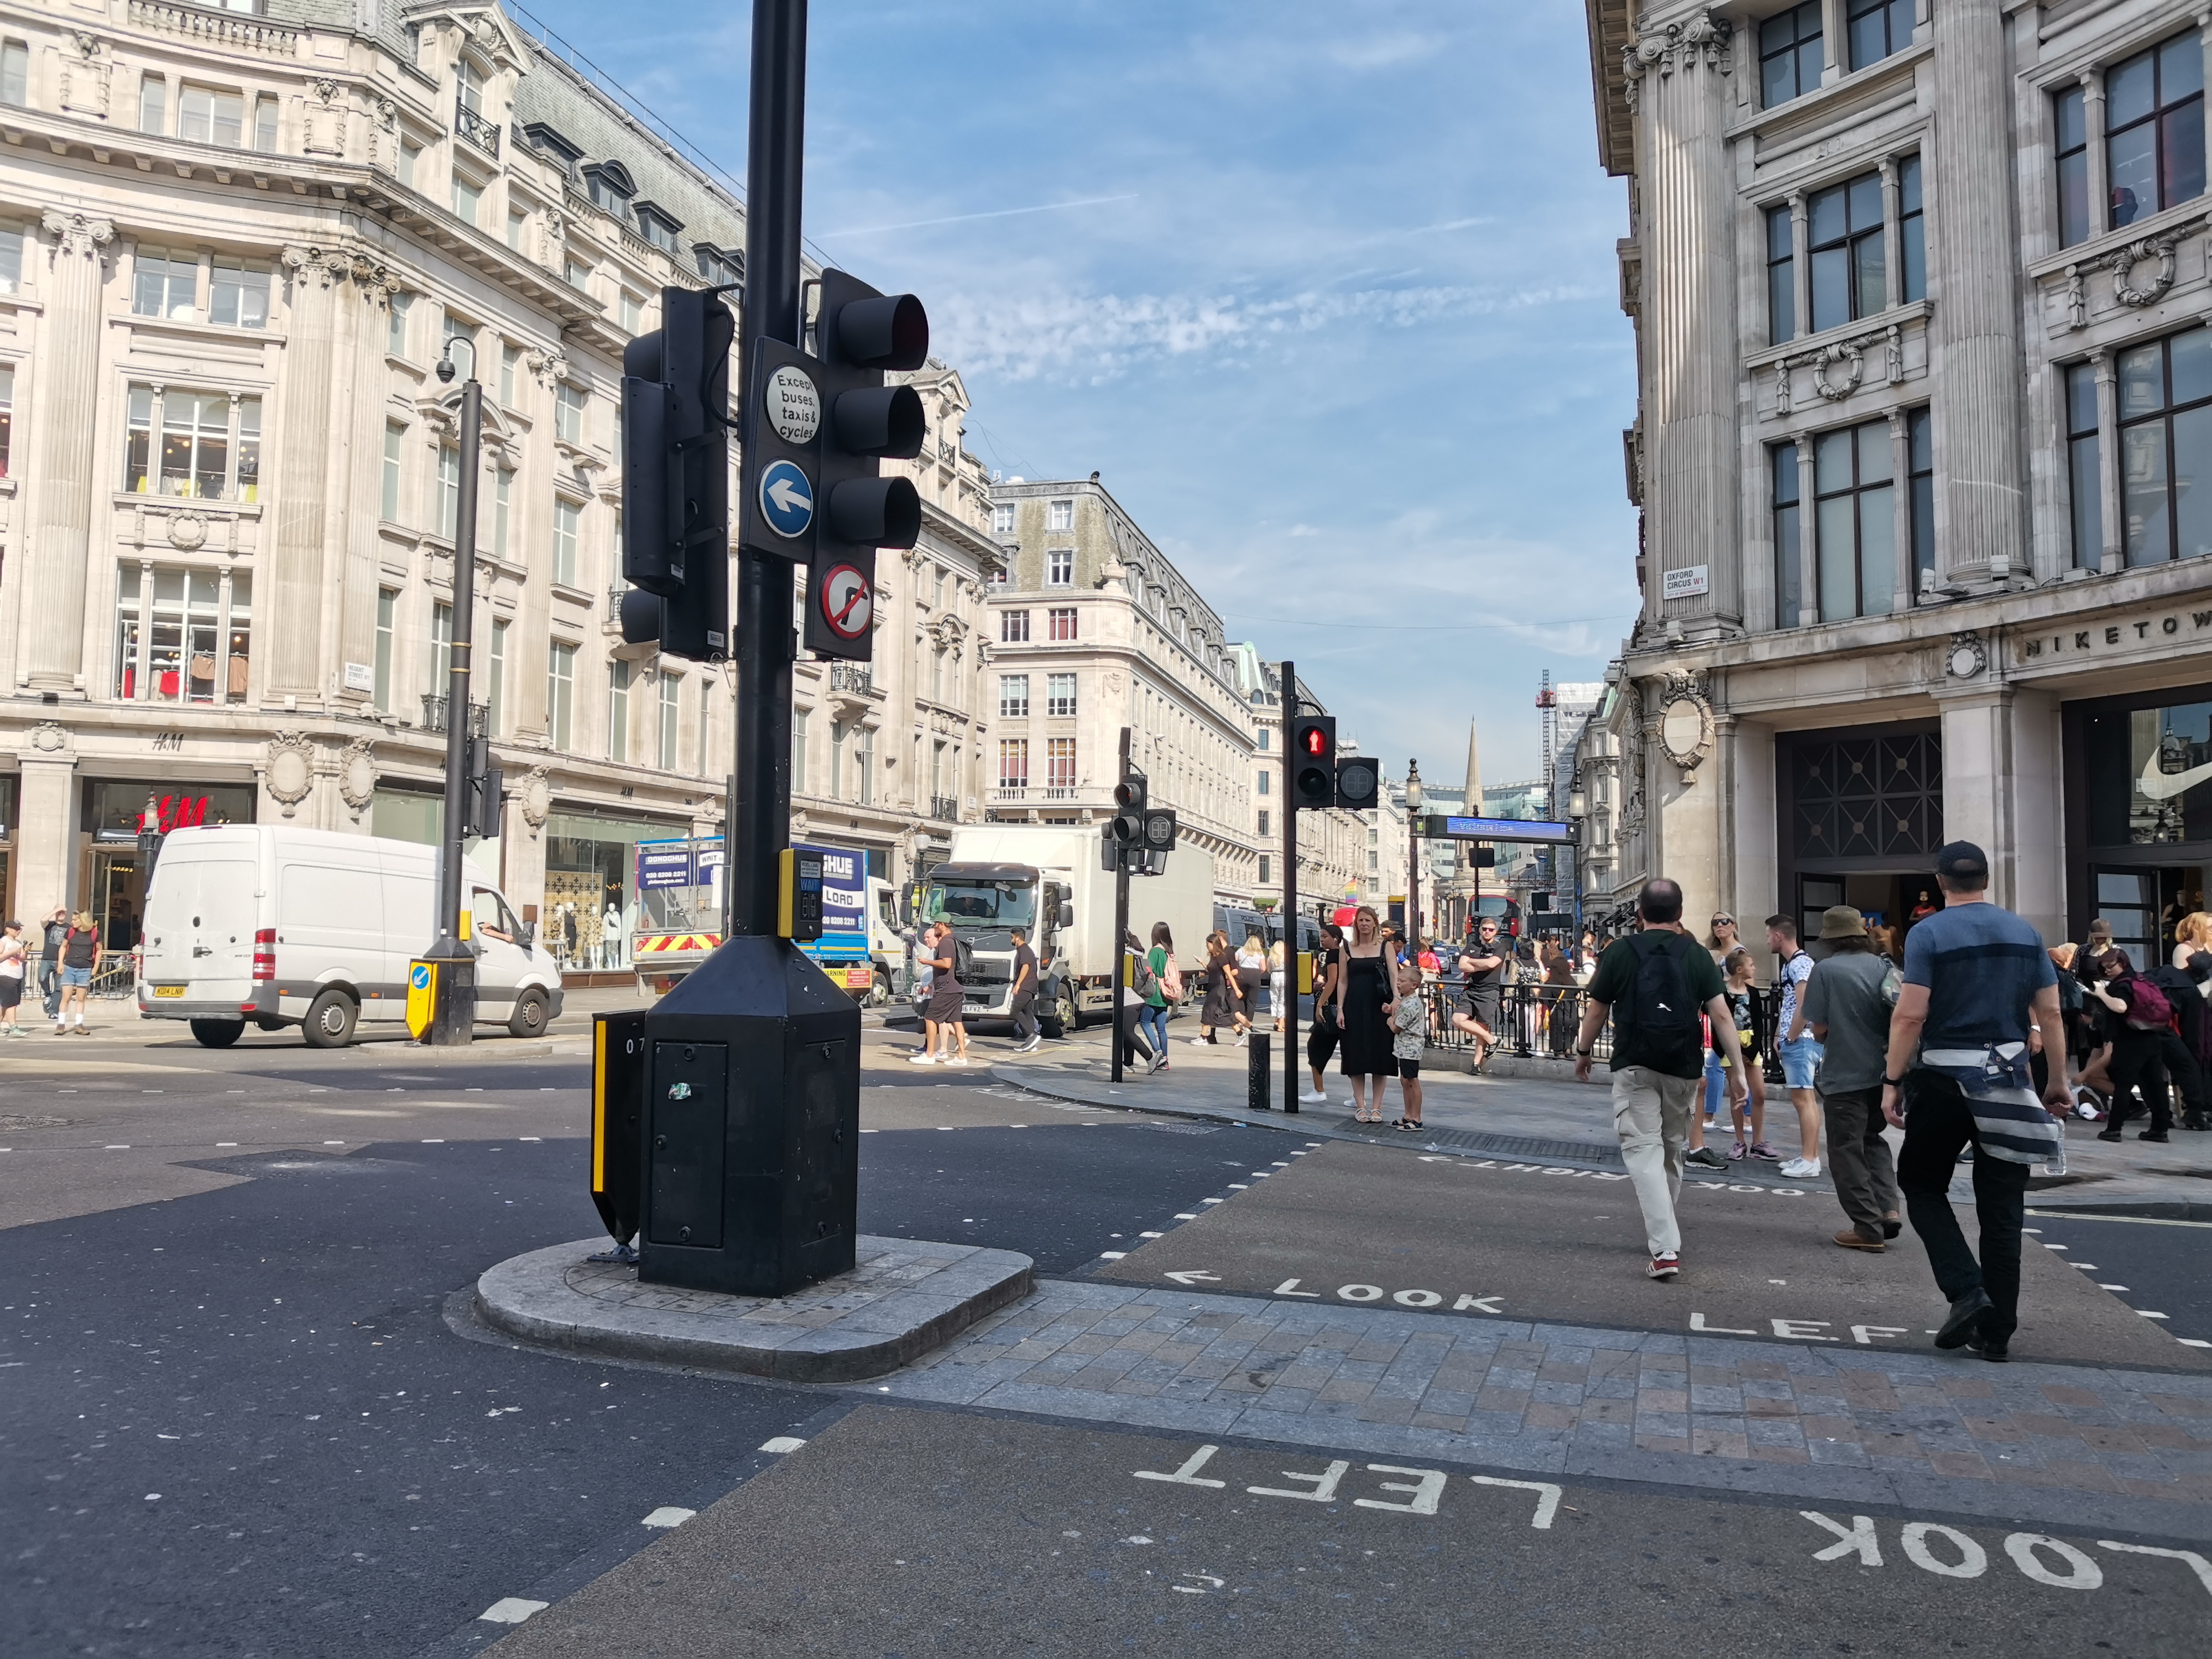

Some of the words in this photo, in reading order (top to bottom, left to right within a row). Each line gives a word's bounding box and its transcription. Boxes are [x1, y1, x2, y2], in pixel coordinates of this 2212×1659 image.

[777, 374, 813, 392] Except
[782, 406, 809, 422] taxis
[811, 411, 816, 423] &
[780, 425, 813, 439] cycles
[1667, 570, 1693, 581] OXFORD
[1667, 579, 1691, 589] CIRCUS
[348, 665, 364, 673] REGENT
[152, 733, 184, 752] H&M
[823, 854, 853, 874] GHUE
[801, 878, 819, 891] WAIT
[826, 890, 853, 905] LOAD
[831, 916, 843, 925] 8208
[1273, 1279, 1505, 1314] LOOK
[1133, 1445, 1563, 1528] LEFT
